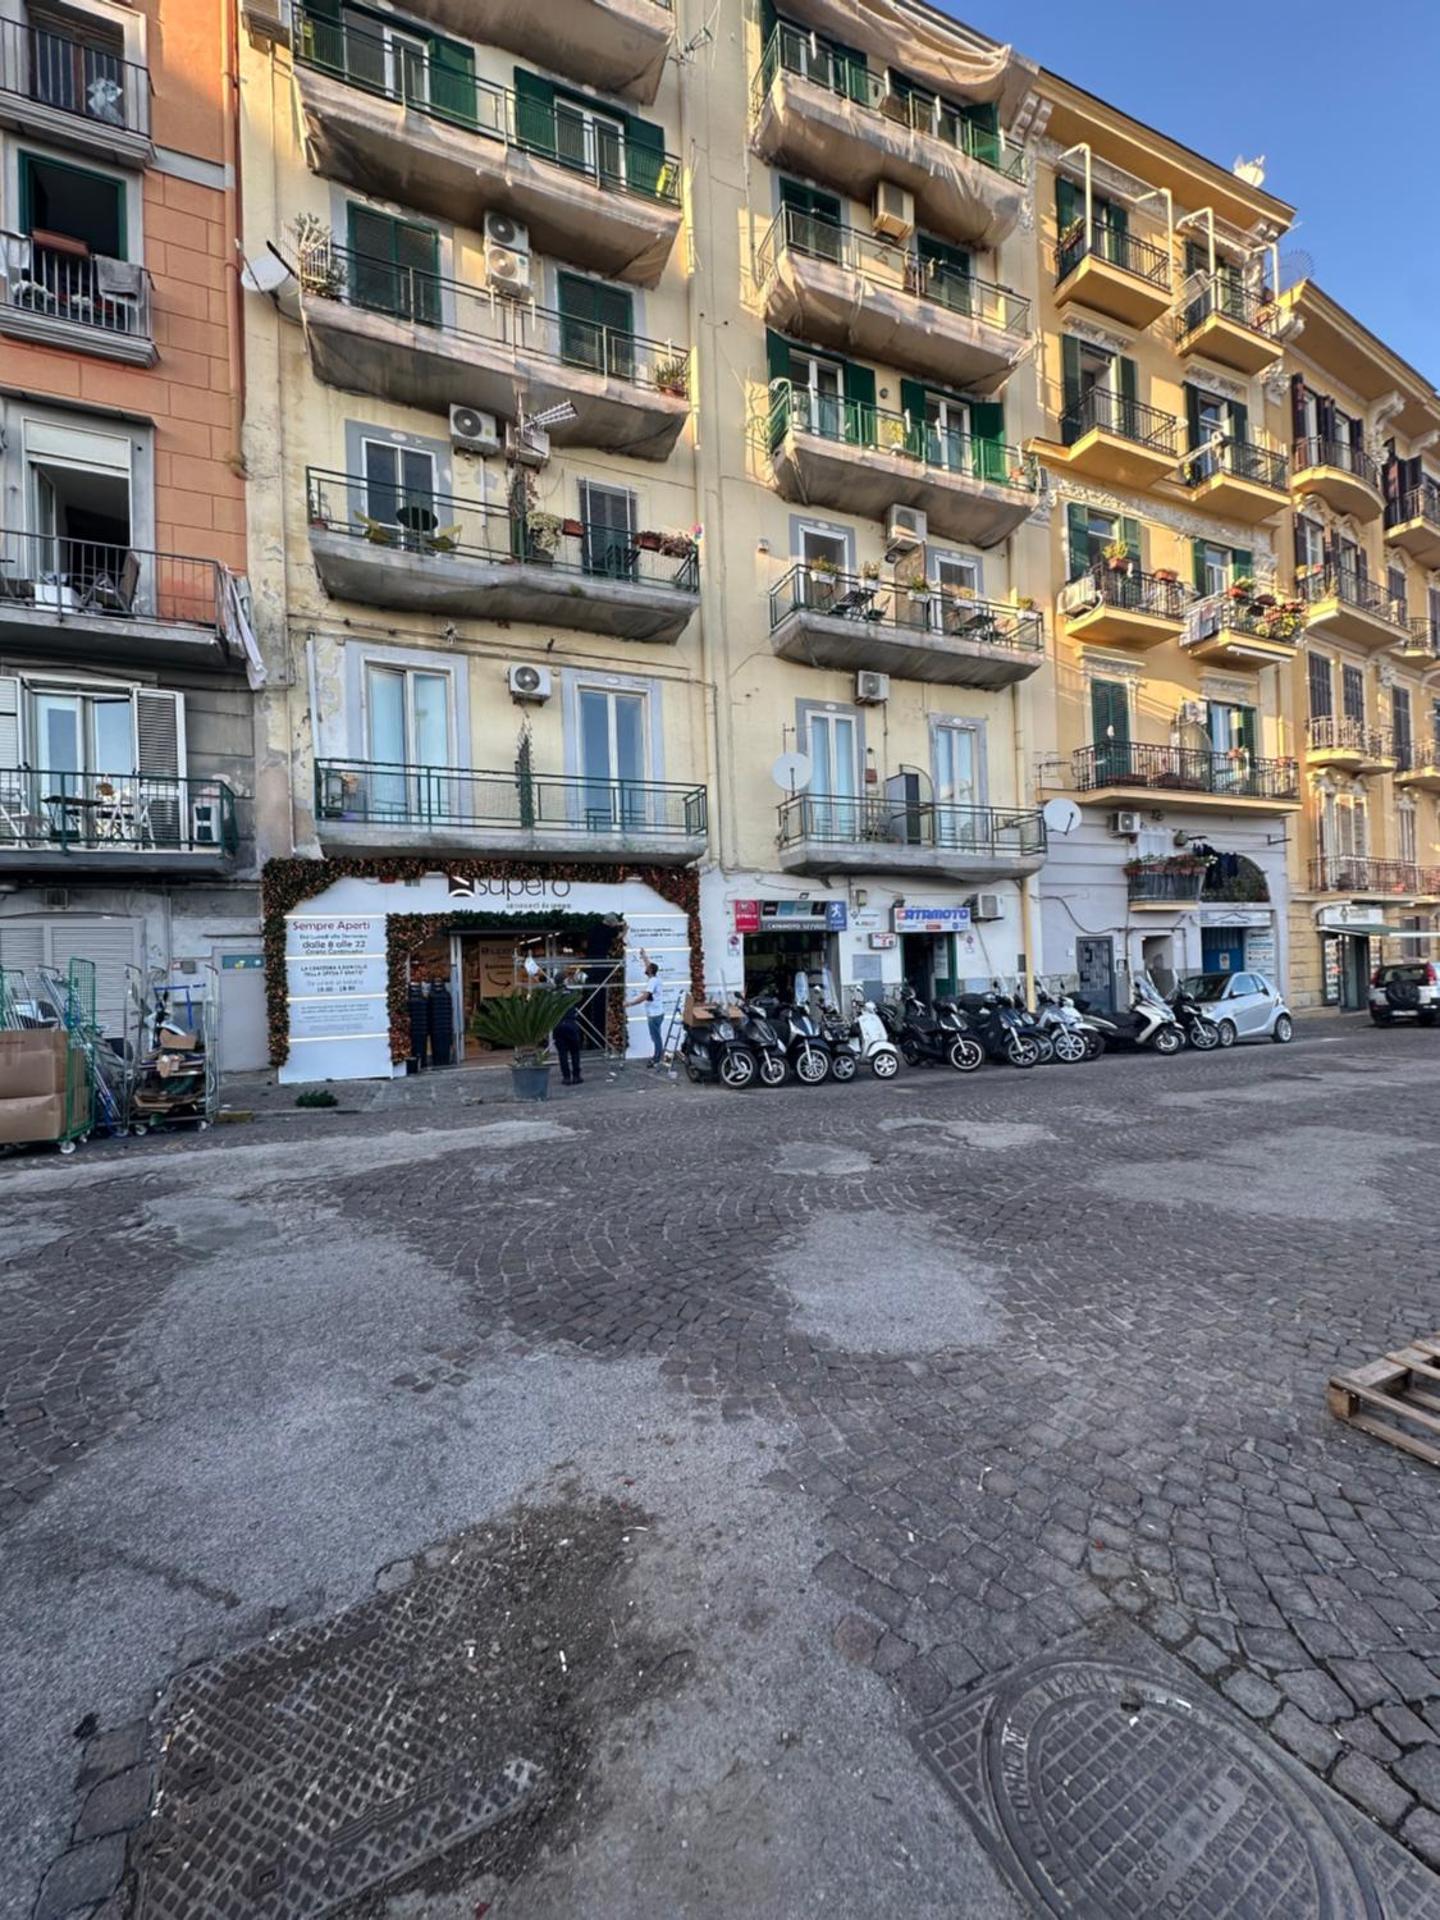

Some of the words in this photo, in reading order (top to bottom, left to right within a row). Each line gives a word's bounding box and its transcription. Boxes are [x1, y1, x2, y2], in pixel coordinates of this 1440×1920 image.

[478, 878, 571, 901] supero
[292, 921, 335, 932] Sempre
[336, 920, 371, 932] Aperti
[302, 940, 326, 949] dalle
[335, 940, 353, 949] alle
[354, 940, 366, 948] 22
